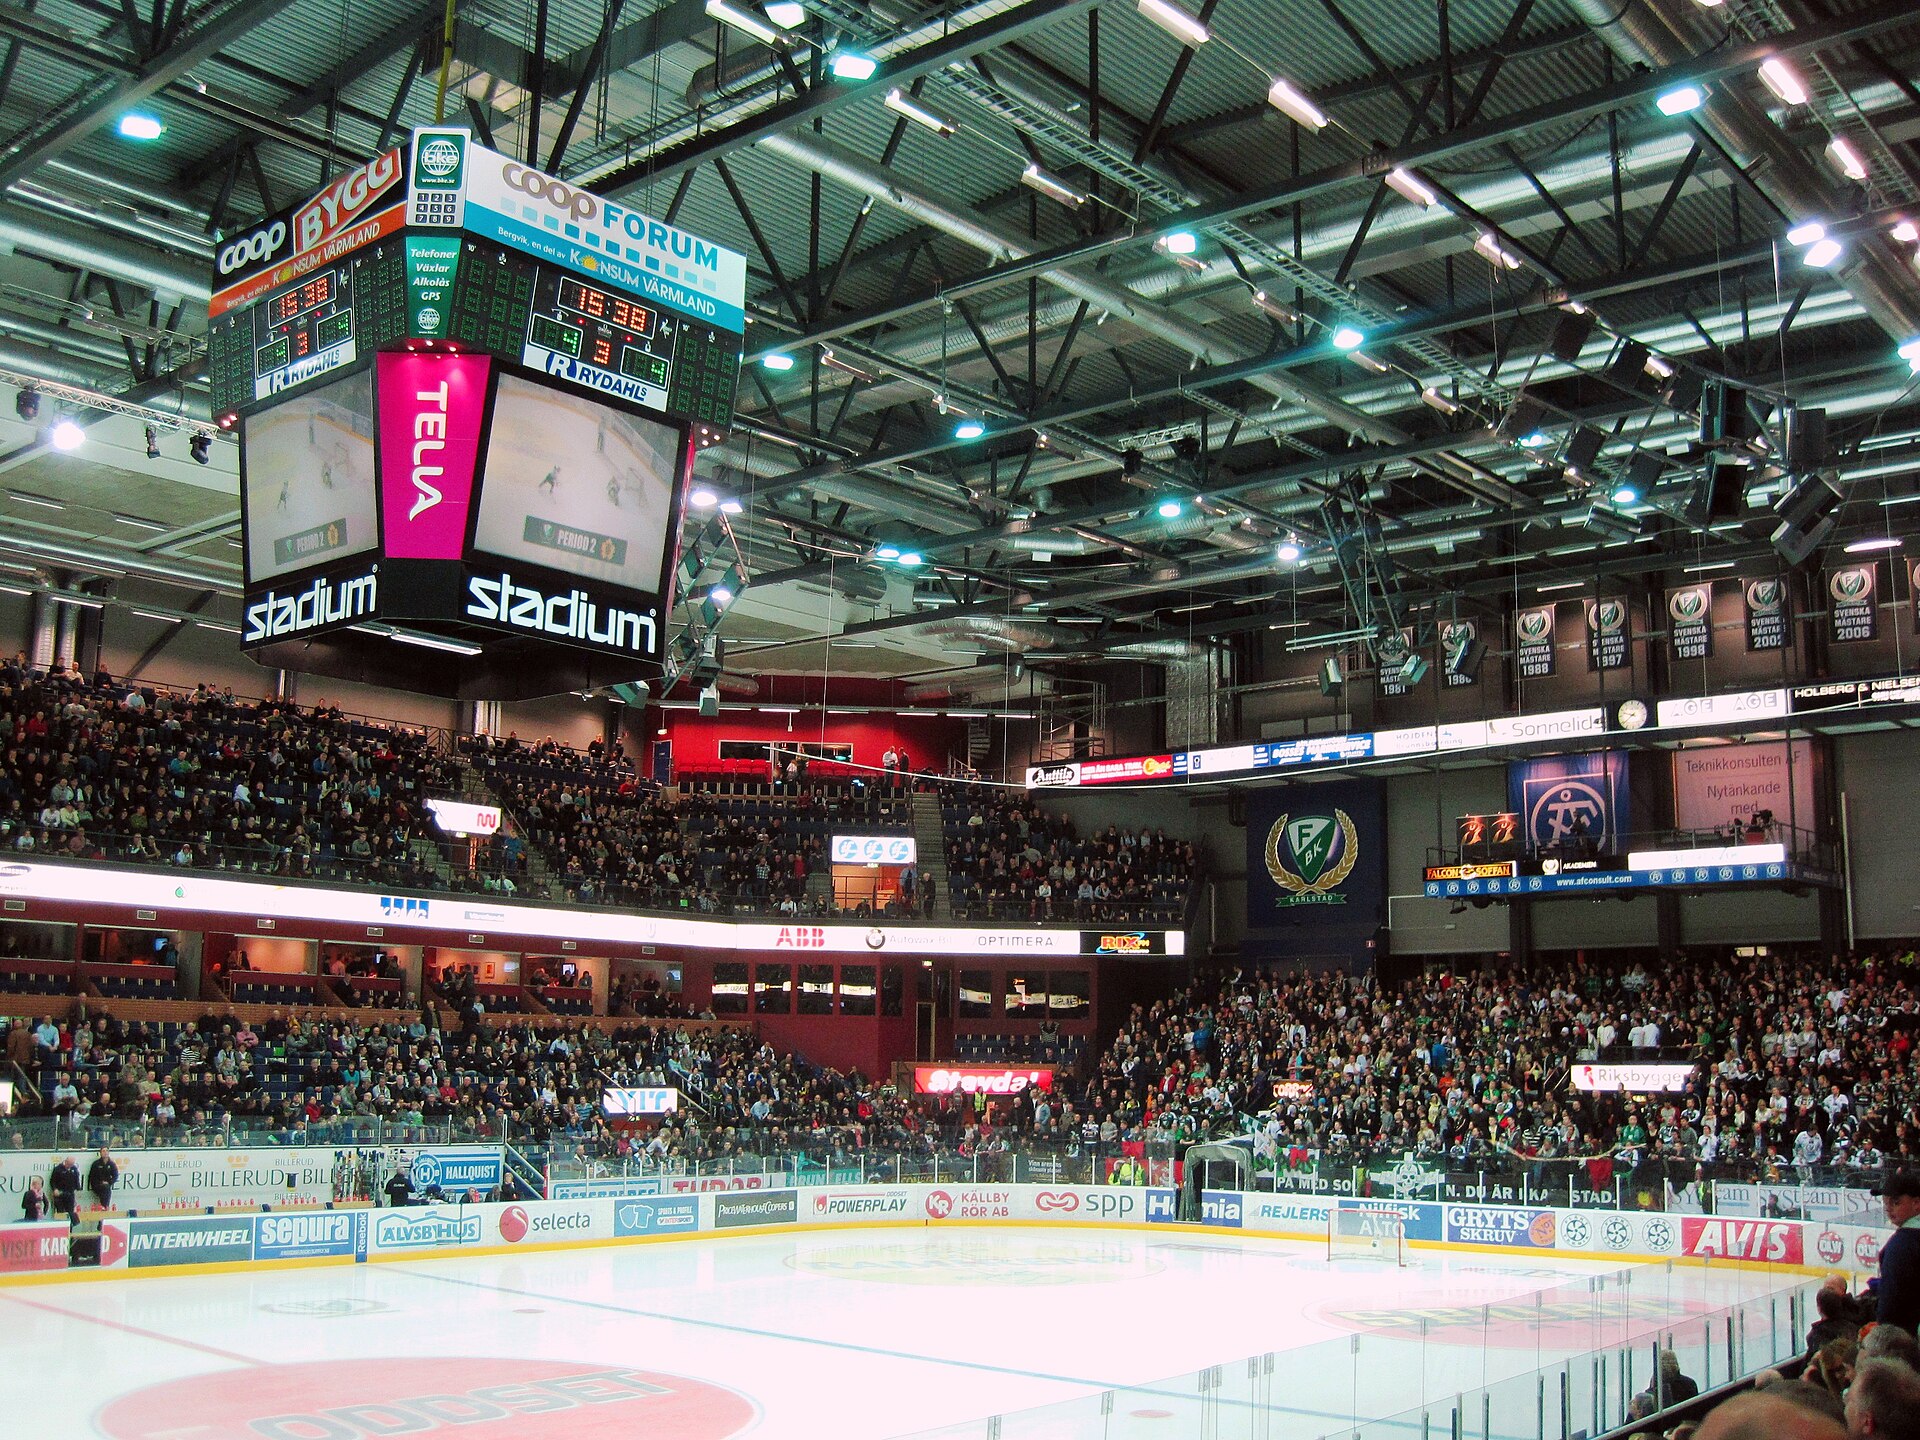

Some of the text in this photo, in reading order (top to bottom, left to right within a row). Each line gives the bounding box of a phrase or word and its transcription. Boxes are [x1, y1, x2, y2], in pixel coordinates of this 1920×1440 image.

[423, 148, 458, 163] bke
[302, 154, 394, 248] BYGG
[324, 222, 381, 261] VÄRMLAND
[603, 203, 719, 272] FORUM
[411, 248, 457, 259] Telefoner
[416, 262, 450, 273] Växlar
[498, 227, 529, 248] Bergvik,
[532, 242, 542, 251] en
[543, 244, 555, 255] del
[642, 275, 716, 316] VÄRMLAND
[280, 277, 328, 318] 15:38
[421, 291, 441, 301] GPS
[578, 288, 647, 331] 15:38
[338, 314, 349, 336] 4
[297, 331, 308, 356] 3
[563, 332, 578, 353] 4
[276, 341, 287, 363] 4
[594, 339, 610, 365] 3
[650, 362, 665, 384] 4
[556, 529, 597, 551] PERIOD 2
[1751, 616, 1780, 626] SVENSK
[1834, 607, 1871, 618] SVENSKA
[1674, 625, 1707, 637] SVENSKA
[1837, 627, 1870, 640] 2006
[1592, 636, 1624, 647] SENSKA
[1592, 644, 1625, 656] MSTARE
[1519, 646, 1550, 656] SVENSKA
[1677, 645, 1706, 659] 1998
[1523, 663, 1549, 676] 1988
[1794, 684, 1855, 698] HOLBERG
[1685, 753, 1782, 773] Teknikkonsulten
[1707, 780, 1781, 800] Nytänkande
[1730, 801, 1759, 814] med
[1297, 823, 1314, 849] F
[1425, 867, 1462, 881] FALCON
[1556, 875, 1633, 887] www.afconsult.com
[1289, 894, 1333, 903] KARLSTAD
[776, 927, 825, 947] ABB
[978, 936, 1054, 946] OPTIMERA
[1101, 936, 1140, 949] RIX
[1598, 1068, 1682, 1086] Riksbygge
[616, 1090, 667, 1110] YIT
[160, 1159, 202, 1169] BILLERUD
[275, 1158, 314, 1166] BILLERUD
[192, 1168, 284, 1188] BILLERUD
[446, 1165, 497, 1181] HALLQUIST
[961, 1190, 1010, 1203] KÄLLBY
[1491, 1185, 1513, 1200] ÄR
[828, 1199, 908, 1214] POWERPLAY
[961, 1204, 1009, 1217] RÖR AB
[1085, 1193, 1134, 1218] spp
[1260, 1204, 1330, 1221] REJLERS
[1359, 1203, 1421, 1220] Nilfisk
[531, 1211, 591, 1231] selecta
[1449, 1208, 1530, 1230] GRYTS
[261, 1214, 349, 1246] sepura
[357, 1213, 368, 1253] Reebok
[382, 1221, 476, 1242] ÄLVSBYHUS
[1460, 1228, 1516, 1243] SKRUV
[131, 1228, 252, 1250] INTERWHEEL
[1693, 1220, 1791, 1260] AVIS
[247, 1369, 675, 1440] ODDSET
